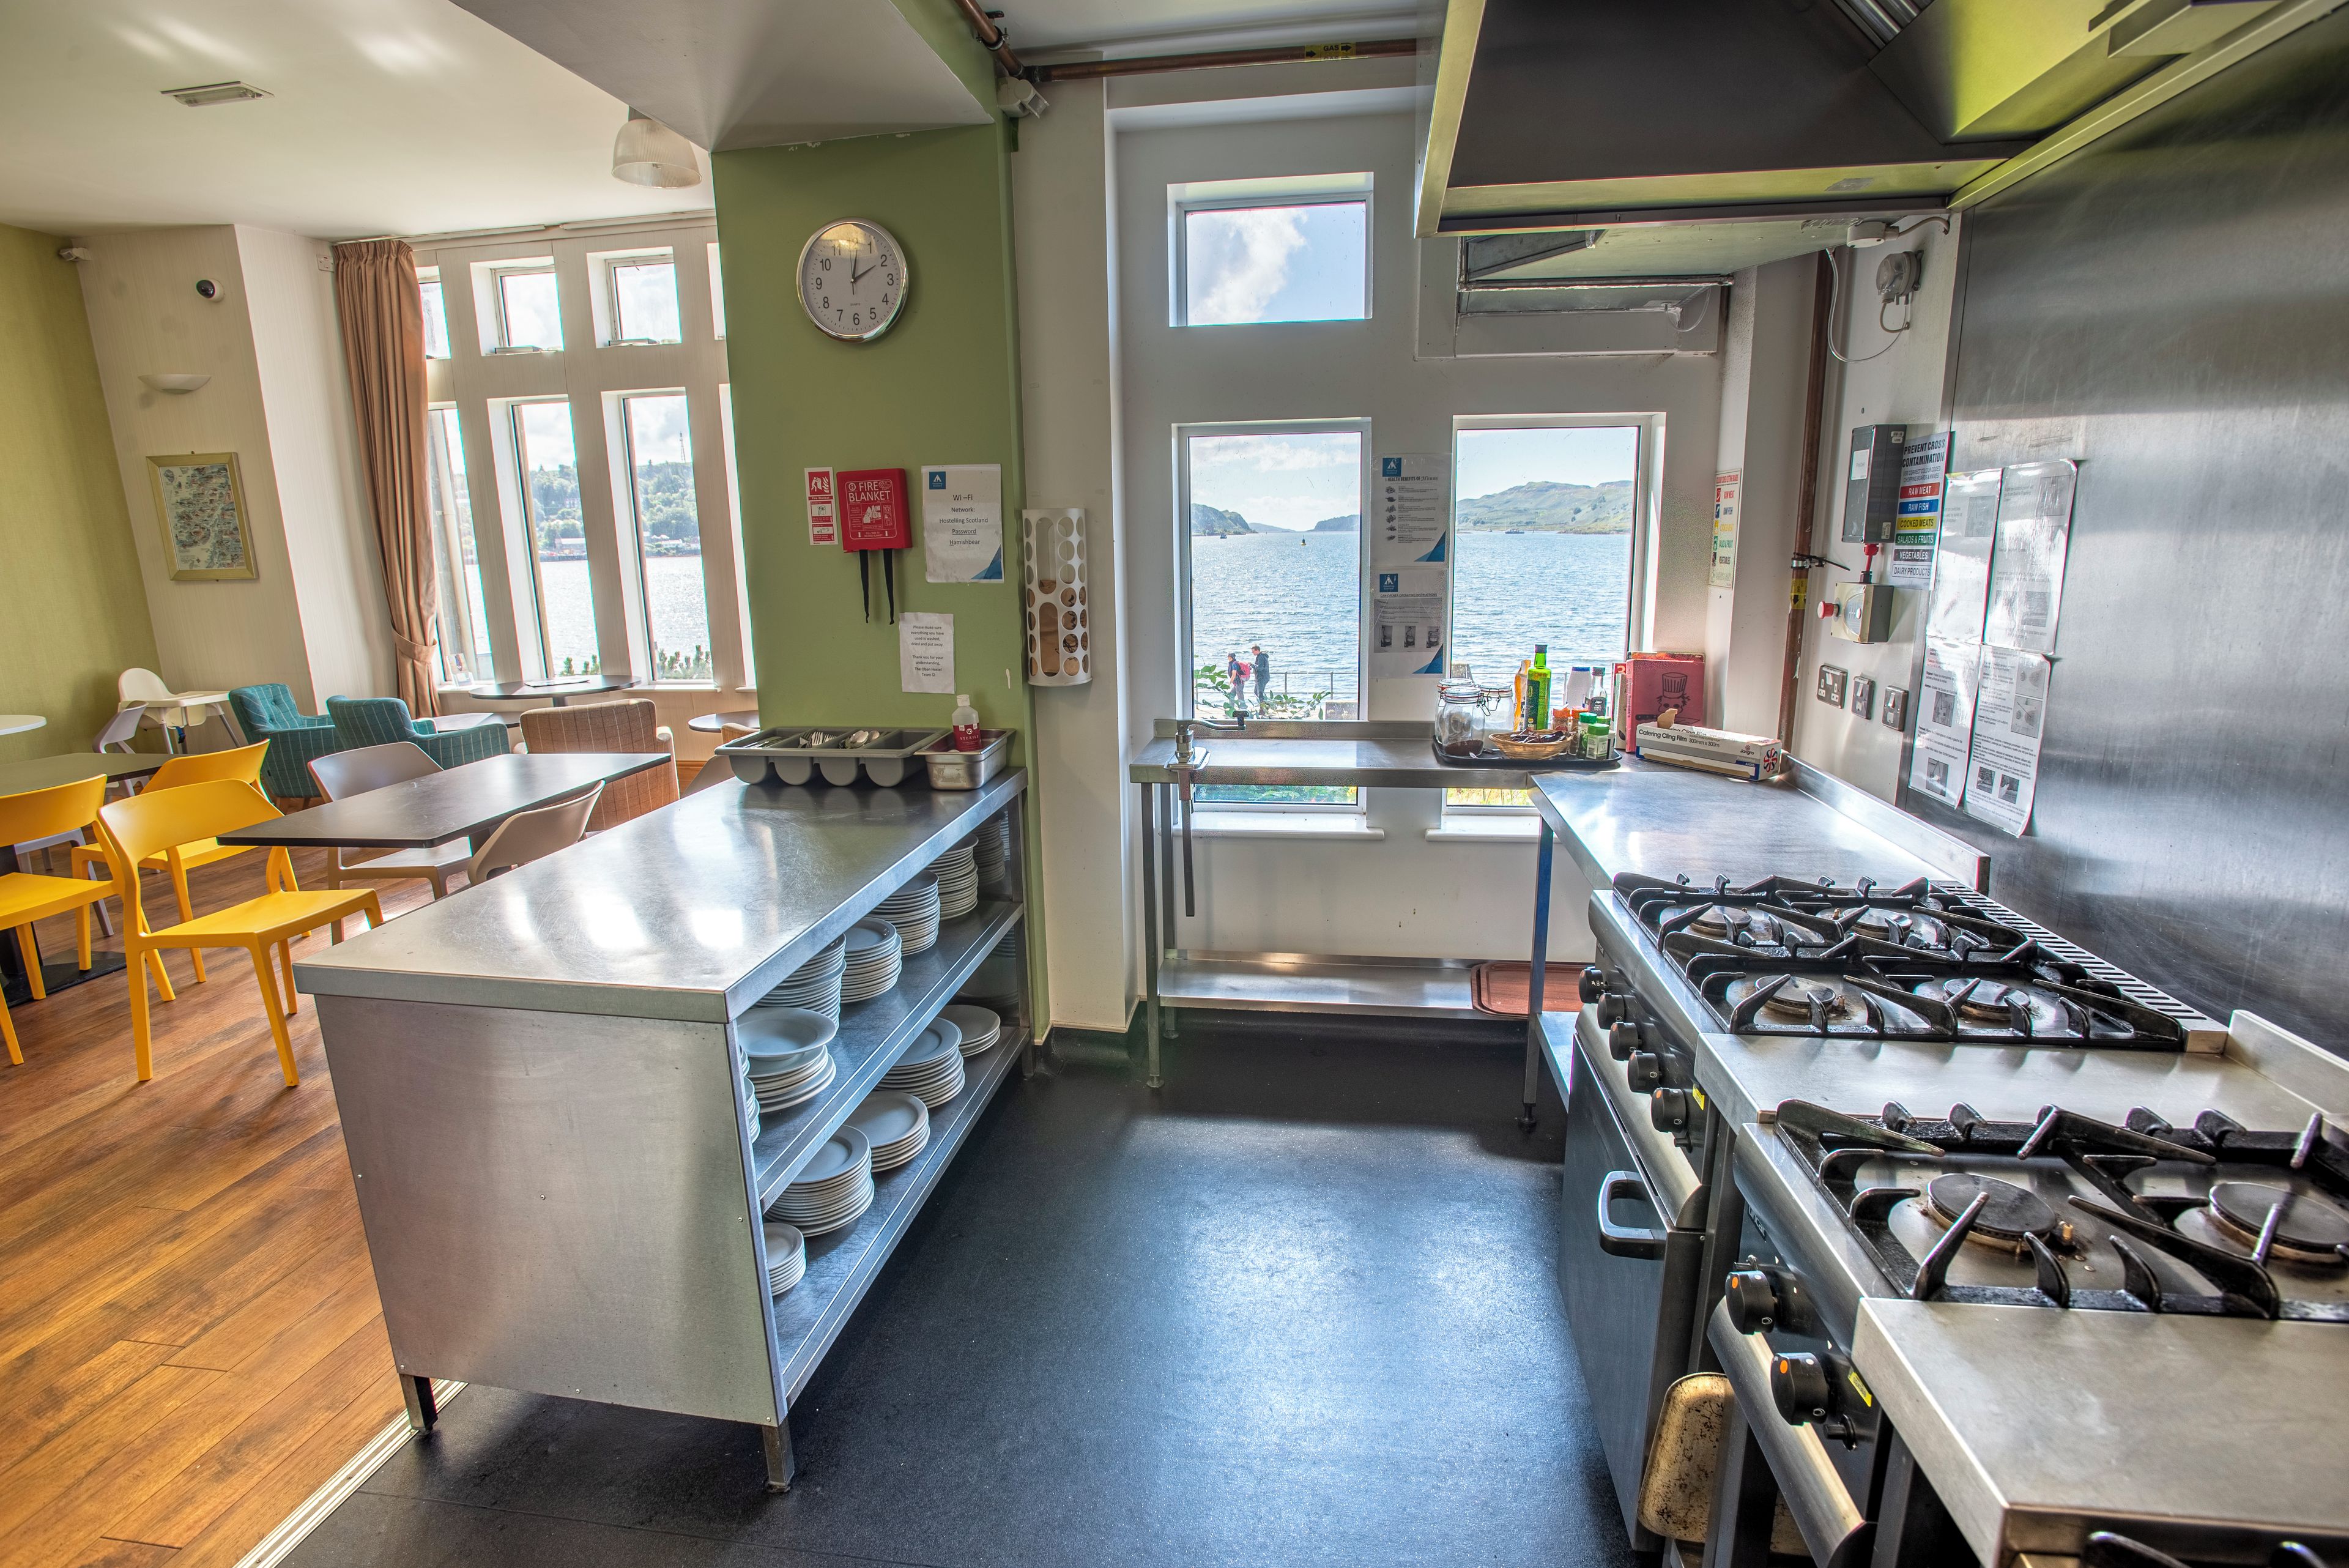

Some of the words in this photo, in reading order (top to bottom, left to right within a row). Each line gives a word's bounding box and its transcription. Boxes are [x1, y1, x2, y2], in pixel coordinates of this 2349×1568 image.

[832, 244, 841, 256] 11
[867, 241, 872, 254] 1
[820, 258, 831, 271] 10
[880, 254, 888, 267] 2
[815, 277, 822, 290] 9
[887, 273, 894, 286] 3
[823, 296, 829, 309] 8
[881, 293, 889, 305] 4
[836, 310, 843, 321] 7
[853, 313, 860, 325] 6
[869, 307, 877, 320] 5
[1904, 443, 1927, 455] PREVENT
[1928, 439, 1945, 450] CROSS
[1902, 451, 1945, 467] CONTAMINATION
[859, 481, 878, 491] FIRE
[1919, 486, 1932, 494] MEAT
[848, 491, 891, 502] BLANKET
[1918, 502, 1929, 511] FISH
[1899, 551, 1928, 560] VEGETABLES
[1907, 568, 1931, 576] PRODUCTS
[1639, 729, 1661, 738] Catering
[1661, 733, 1676, 741] Cling
